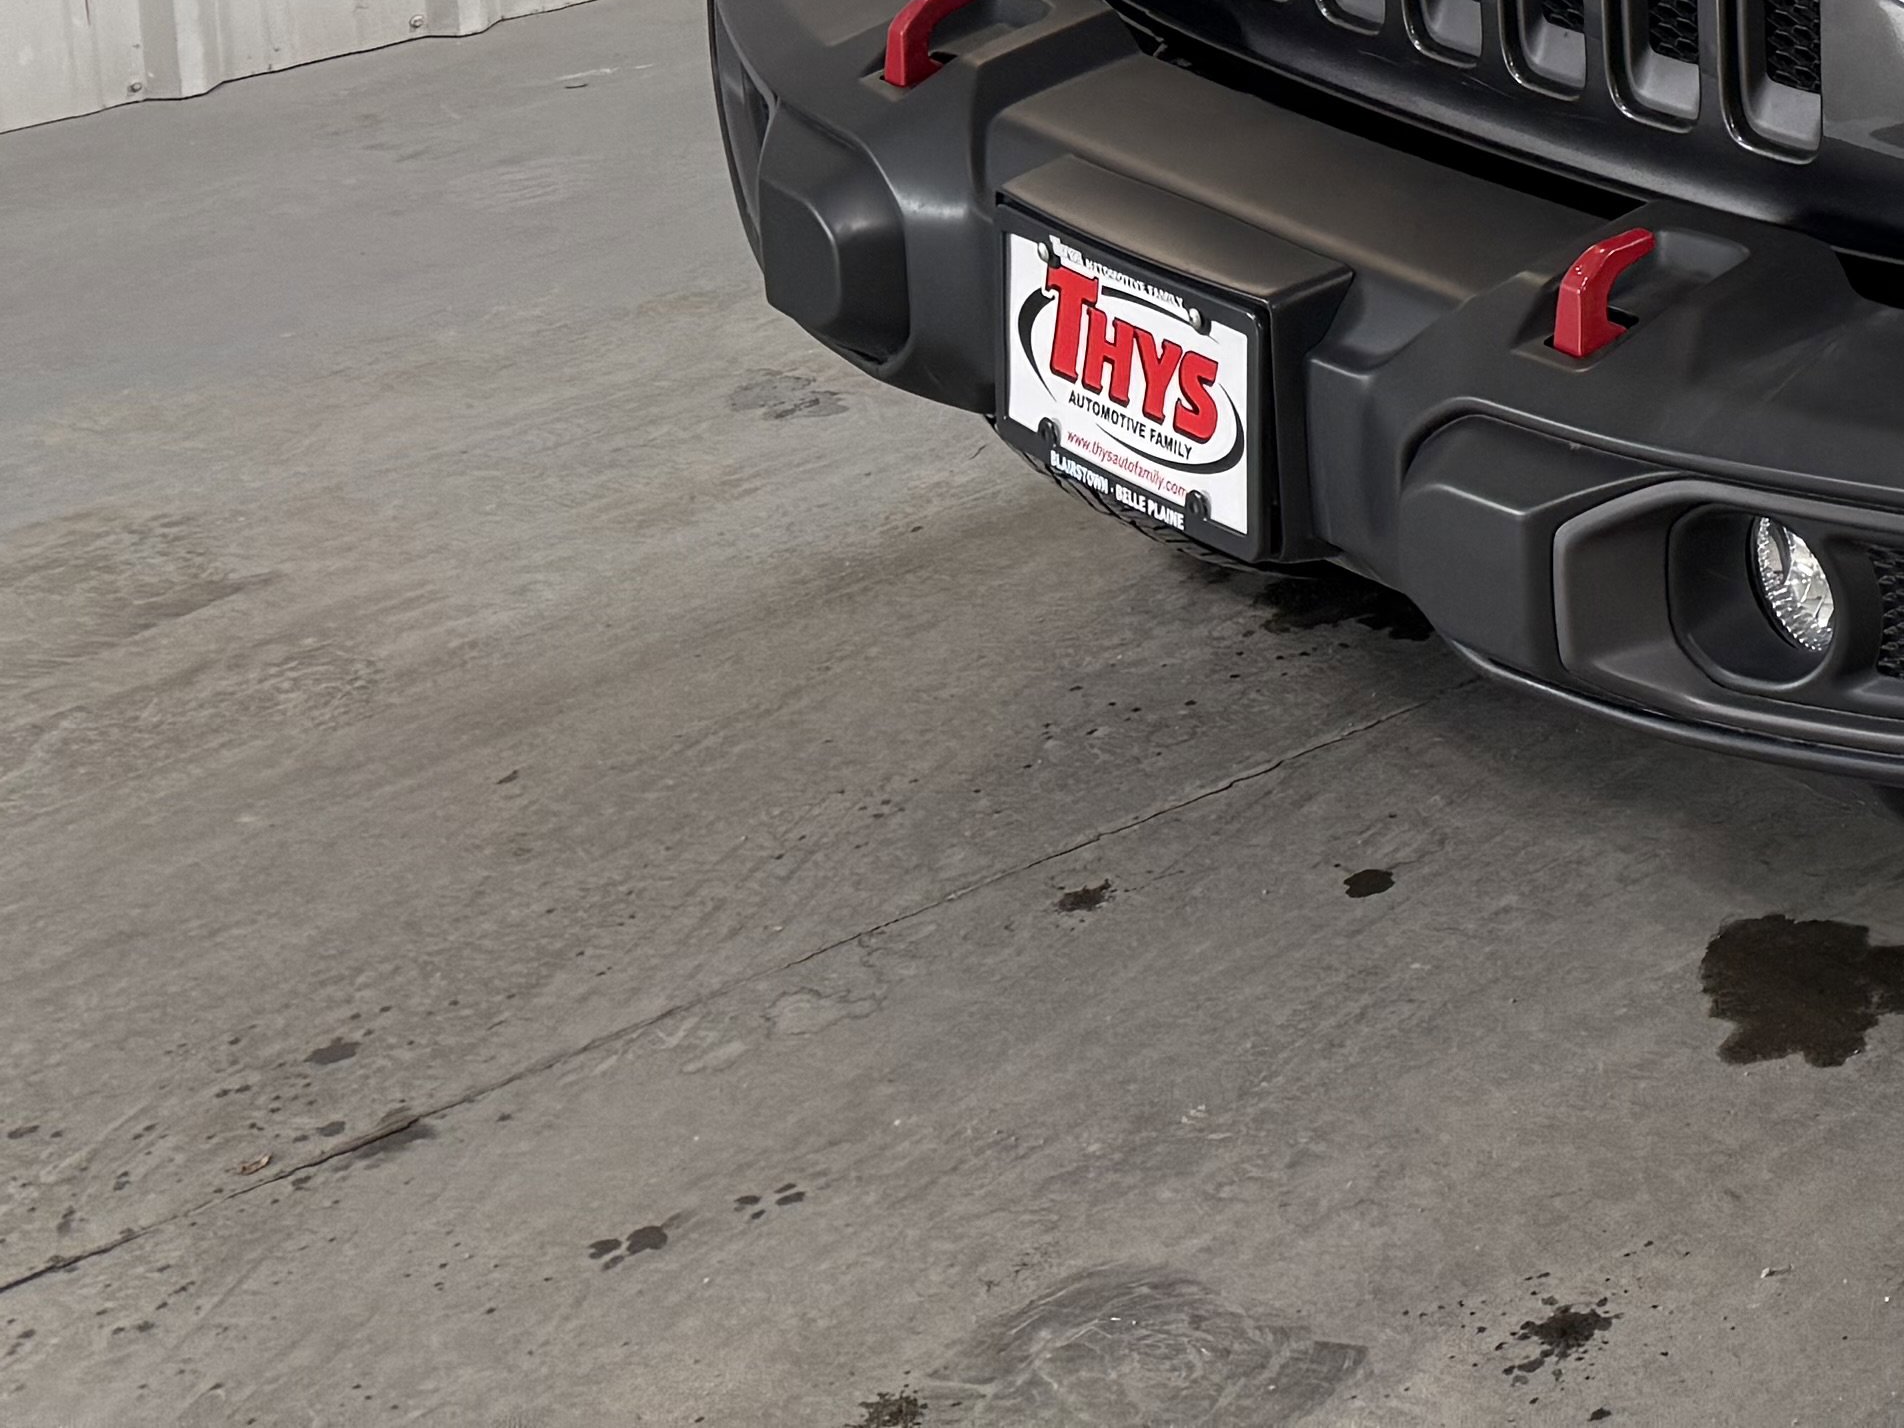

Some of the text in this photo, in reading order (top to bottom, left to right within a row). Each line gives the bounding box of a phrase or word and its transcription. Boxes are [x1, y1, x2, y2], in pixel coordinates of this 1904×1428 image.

[1046, 263, 1219, 444] THYS
[1069, 390, 1193, 460] AUTOMOTIVE FAMILY
[1115, 484, 1147, 512] BELLE
[1147, 499, 1185, 531] PLAINE
